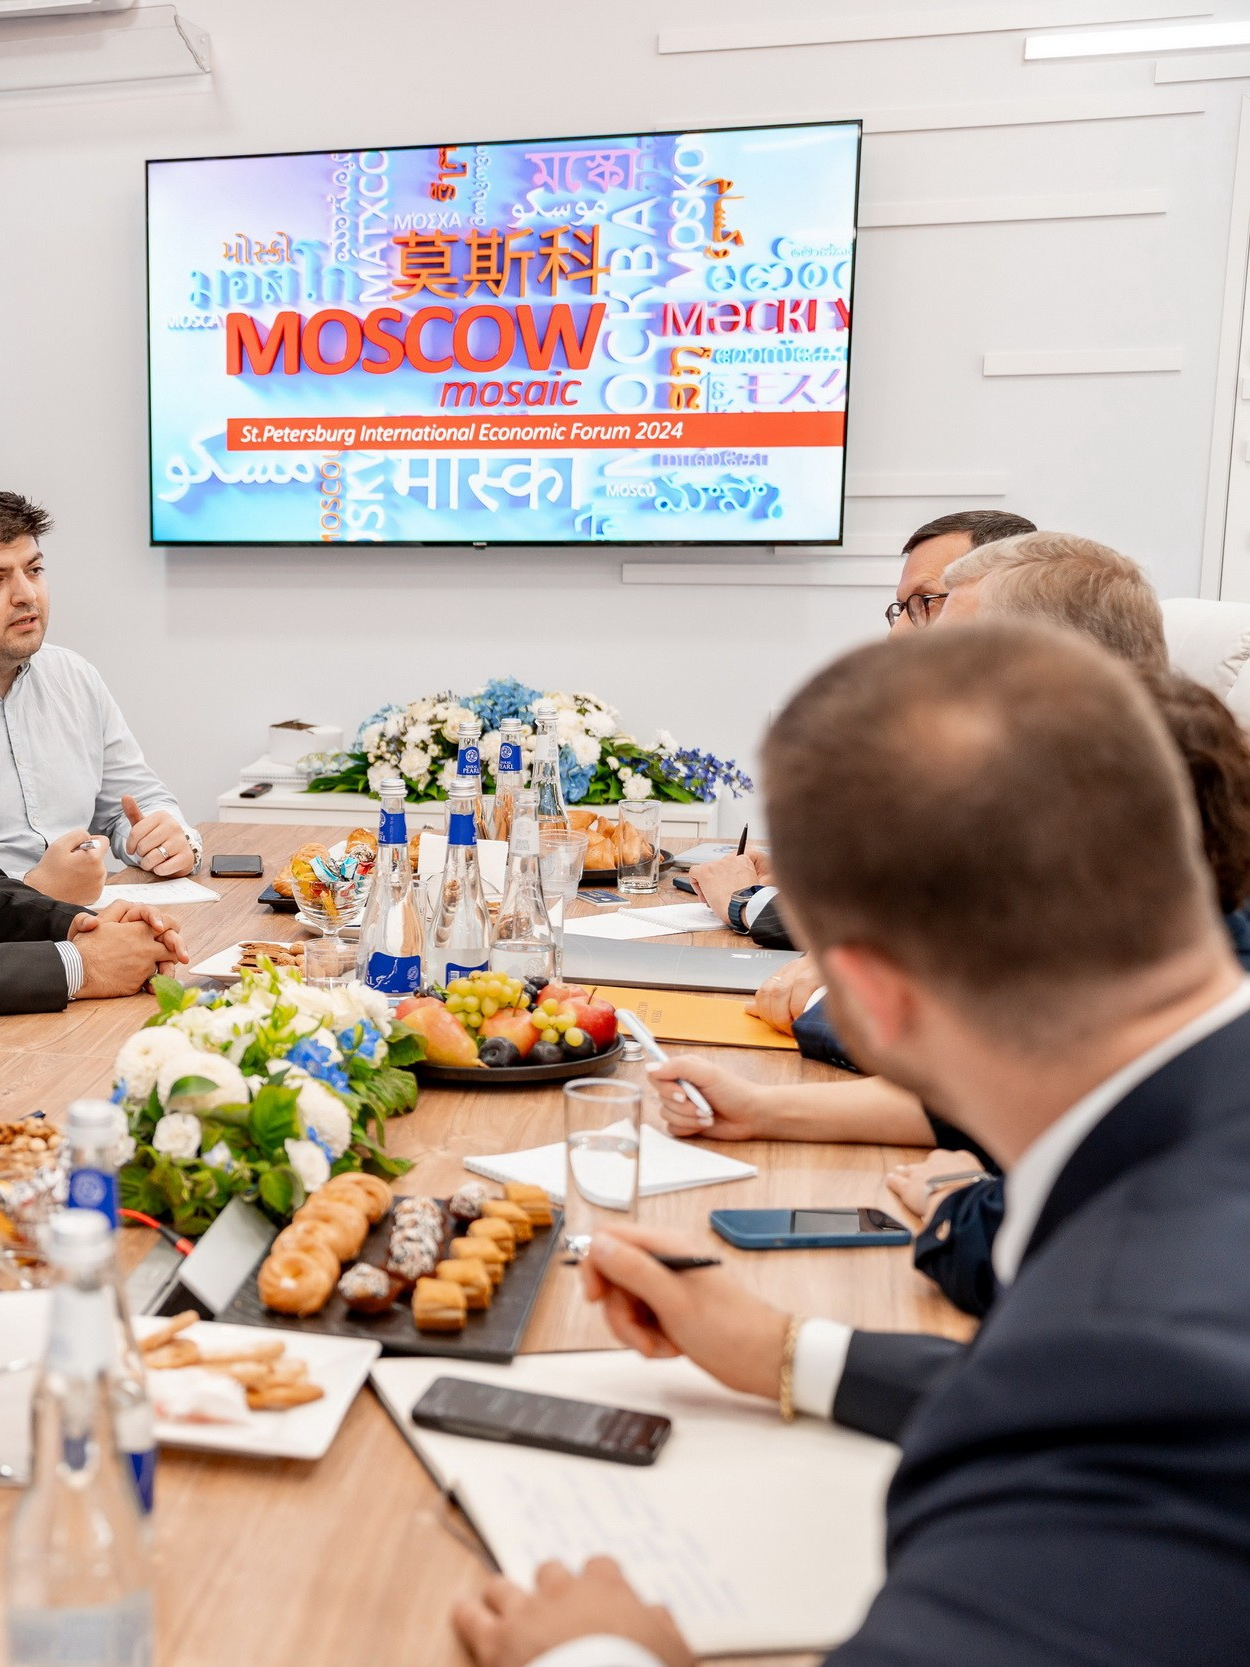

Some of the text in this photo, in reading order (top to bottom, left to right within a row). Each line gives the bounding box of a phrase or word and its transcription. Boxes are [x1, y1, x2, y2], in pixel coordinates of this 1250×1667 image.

[189, 238, 361, 305] มอสโก
[391, 224, 611, 301] 莫斯科
[226, 302, 607, 376] MOSCOW
[440, 370, 582, 408] mosaic
[241, 421, 684, 445] St.Petersburg International Economic Forum 2024
